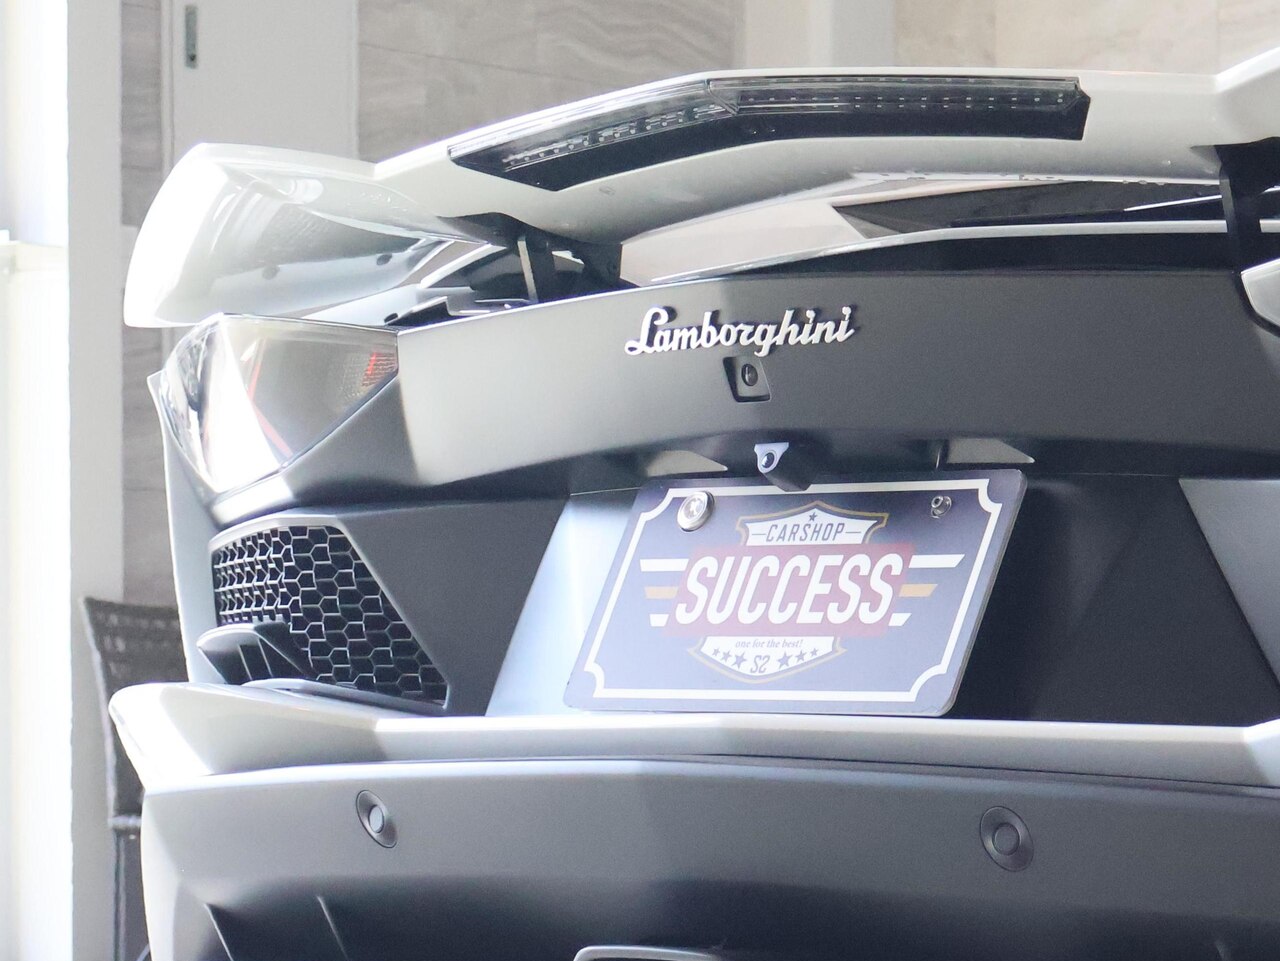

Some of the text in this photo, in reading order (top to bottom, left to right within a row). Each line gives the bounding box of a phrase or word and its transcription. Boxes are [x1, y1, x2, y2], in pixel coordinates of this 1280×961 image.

[624, 306, 855, 357] Lamborghini
[765, 522, 845, 543] CARSHOP
[675, 553, 904, 625] SUCCESS
[735, 637, 804, 649] one for the best!
